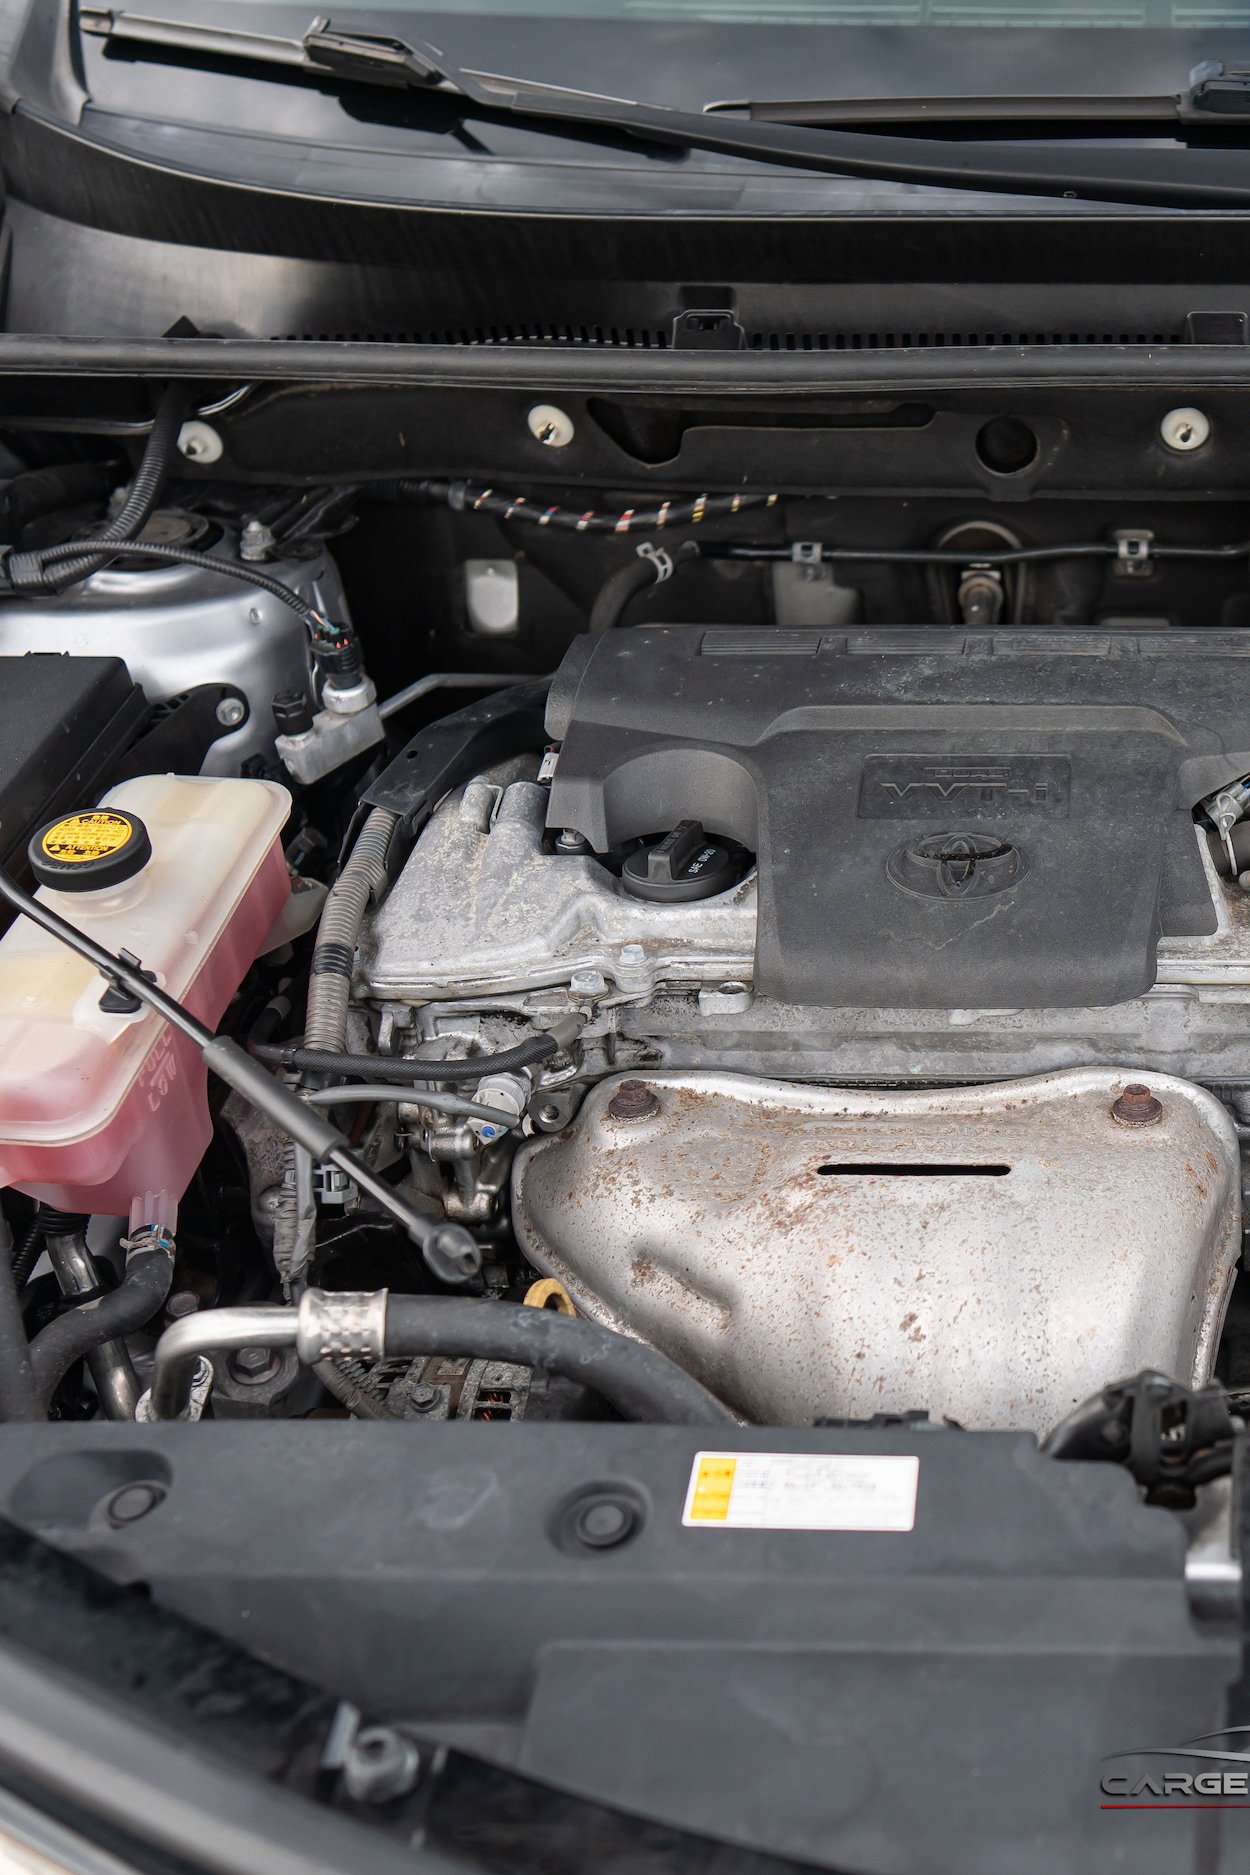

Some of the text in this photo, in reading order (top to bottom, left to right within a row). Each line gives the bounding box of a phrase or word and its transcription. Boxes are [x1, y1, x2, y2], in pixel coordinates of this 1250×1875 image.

[880, 782, 1048, 803] VVT-i
[81, 817, 122, 826] CAUTION
[64, 844, 108, 852] ATTENTION
[687, 861, 704, 874] SAE
